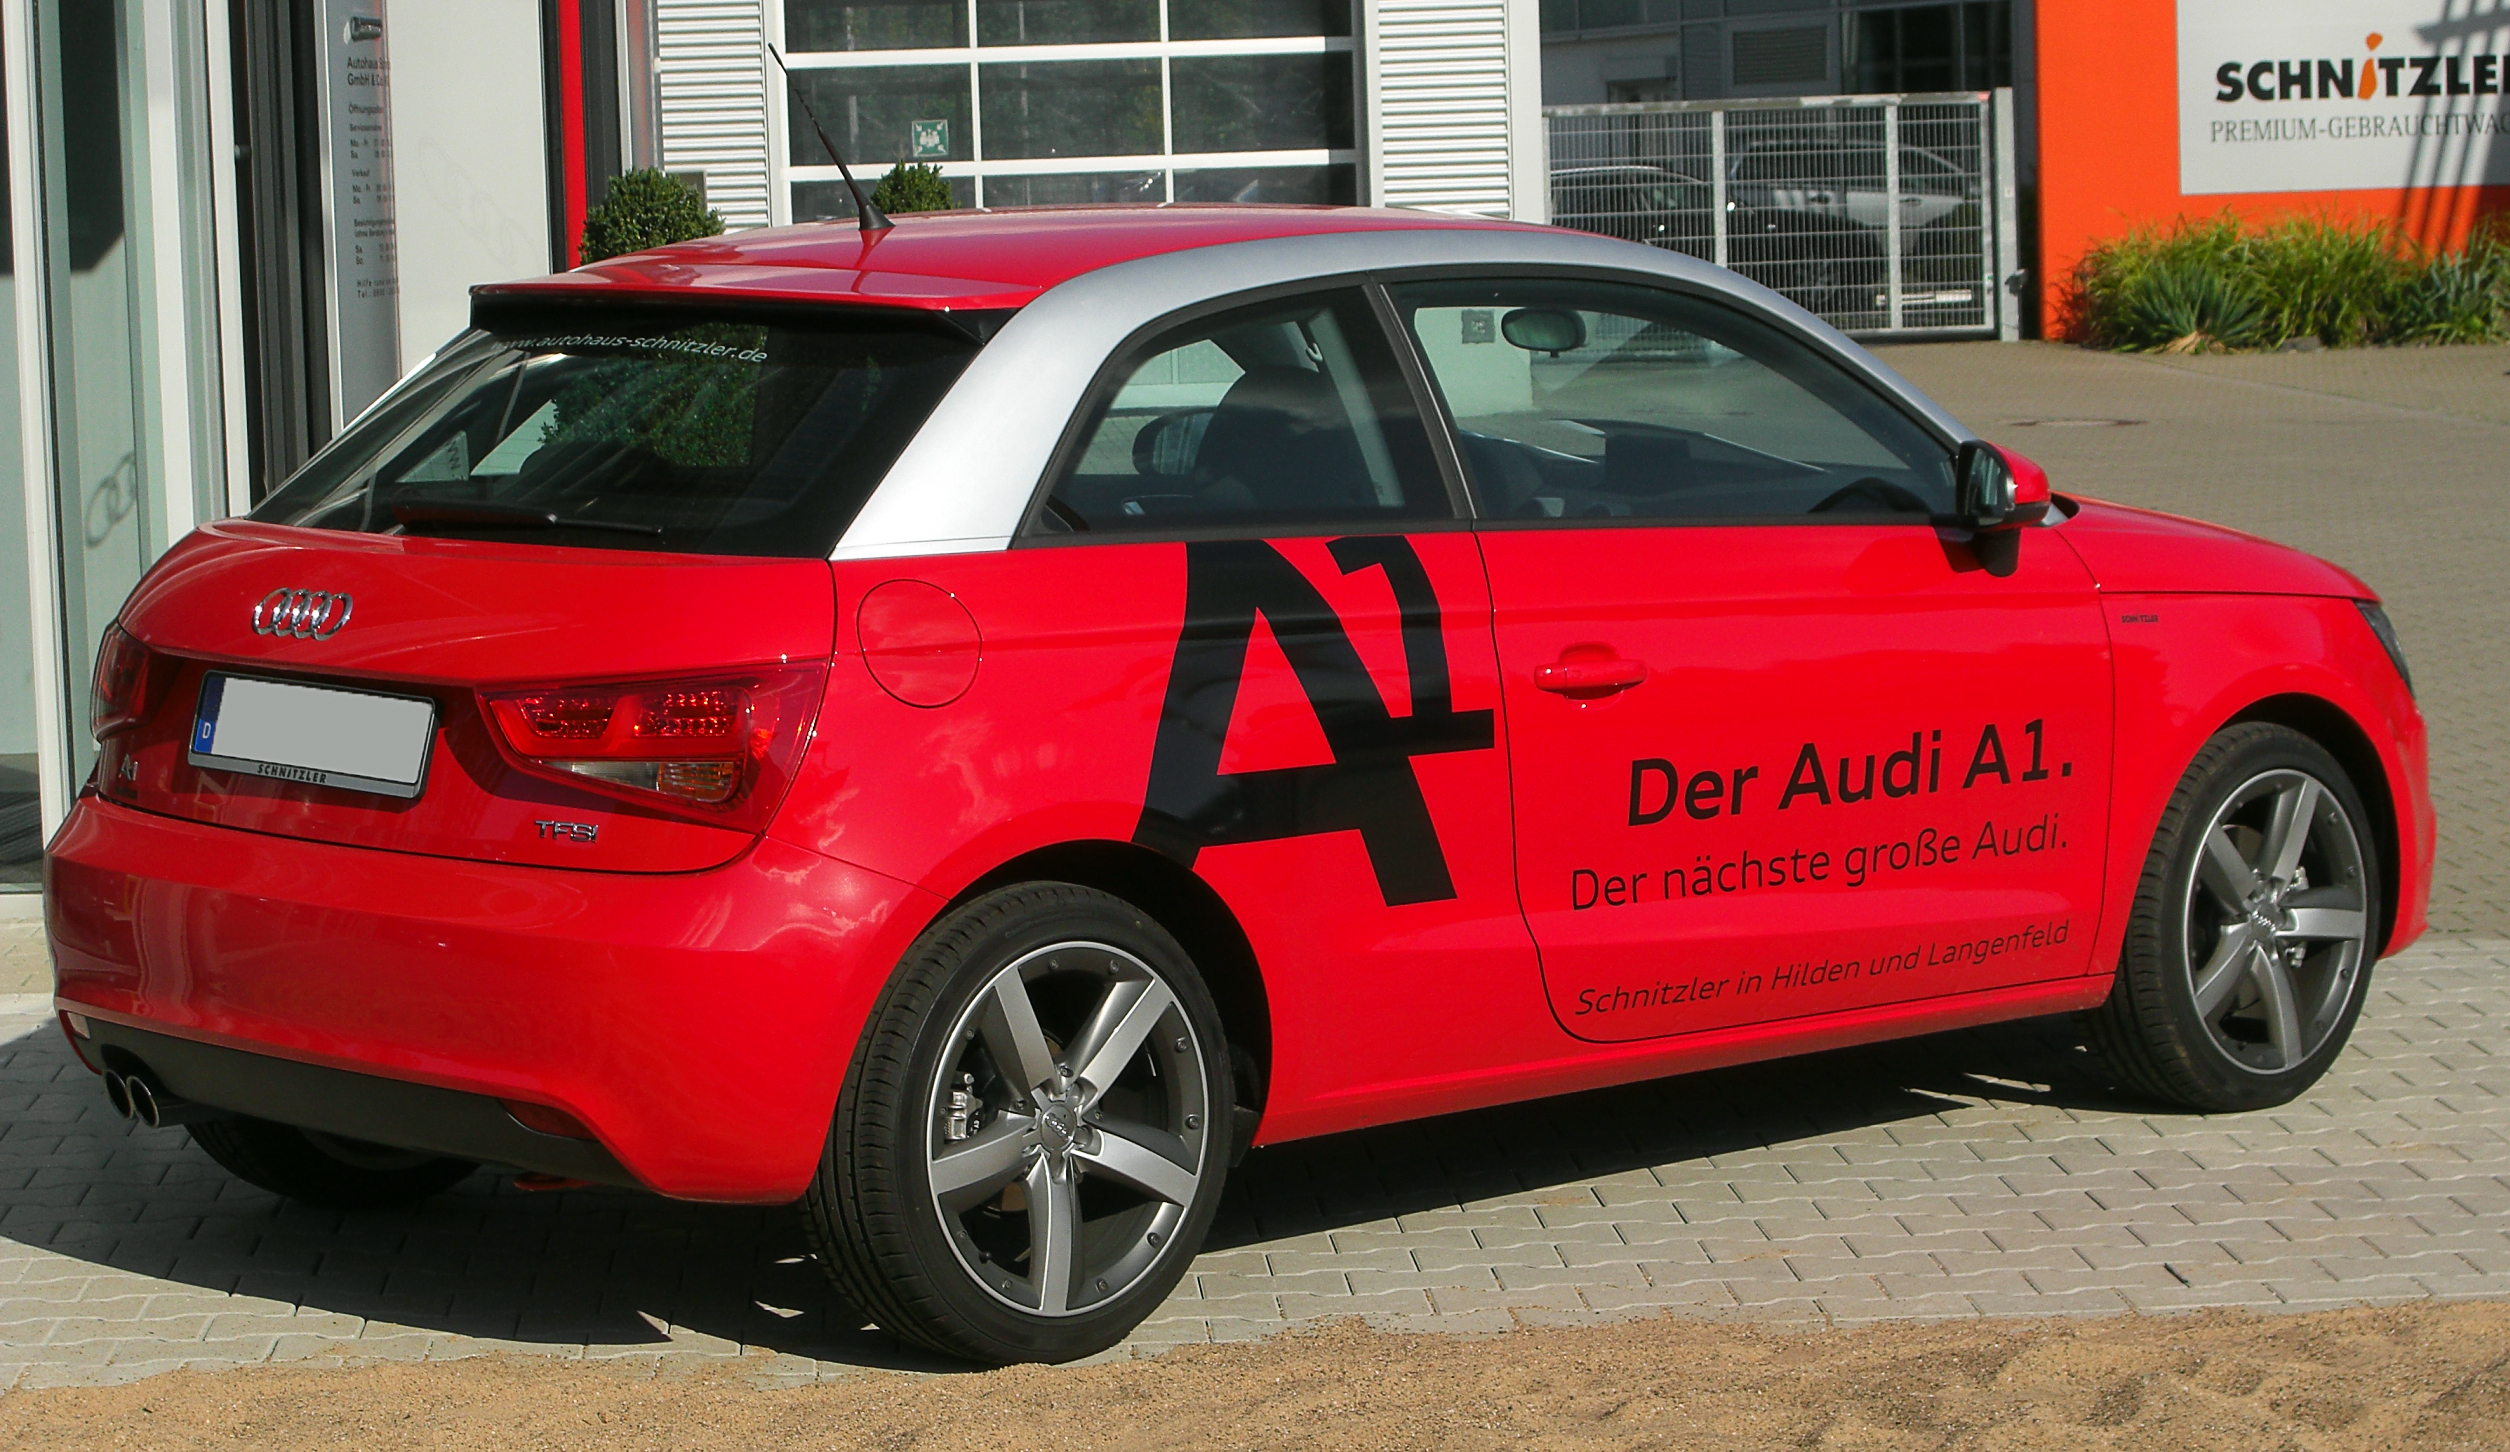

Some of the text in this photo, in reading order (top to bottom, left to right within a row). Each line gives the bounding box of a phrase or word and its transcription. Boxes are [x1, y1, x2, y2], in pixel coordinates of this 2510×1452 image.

[202, 722, 211, 739] D
[1131, 534, 1495, 908] A1
[257, 763, 327, 784] SCHNITZLER
[1628, 718, 2073, 827] Der Audi A1.
[534, 820, 599, 843] TFSI
[1572, 813, 2069, 911] Der nächste große Audi.
[1575, 919, 2070, 1017] Schnitzler in Hilden und Langenfeld
